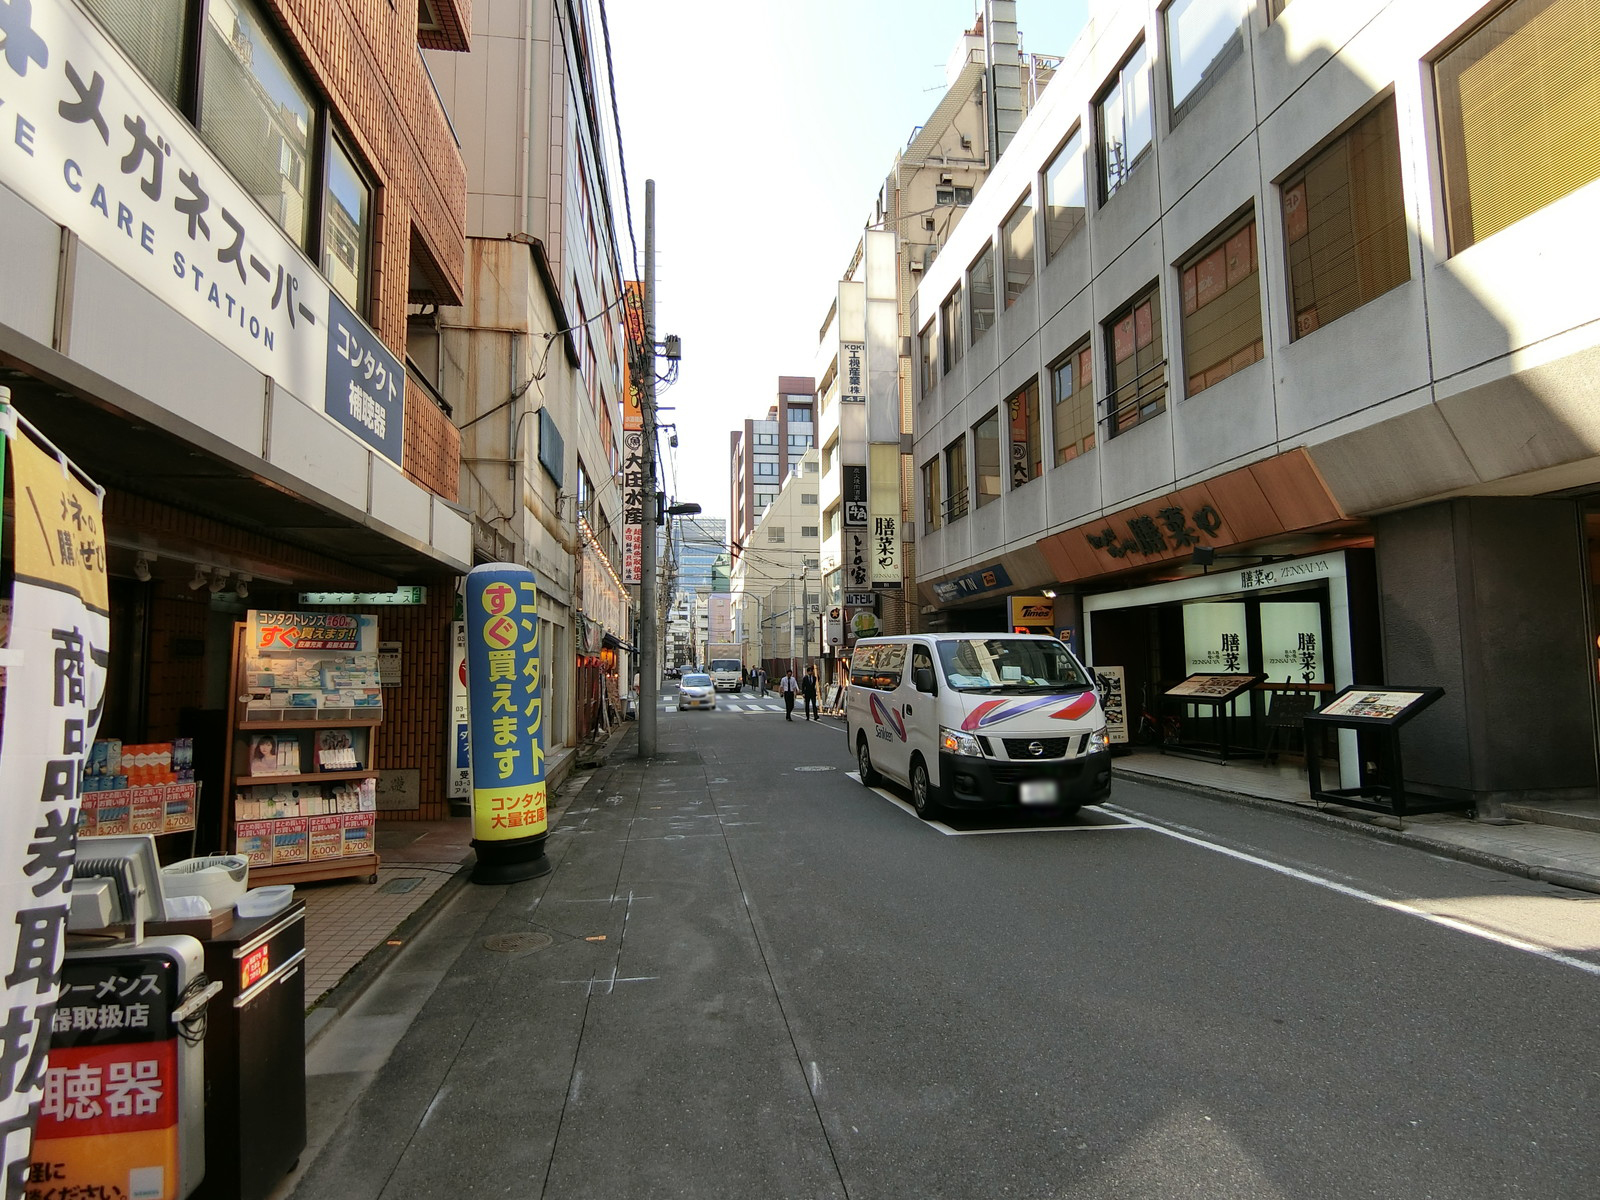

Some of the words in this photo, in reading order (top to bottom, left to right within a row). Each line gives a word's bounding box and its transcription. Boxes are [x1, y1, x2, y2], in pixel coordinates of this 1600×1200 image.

[58, 60, 316, 330] メガネスーパー
[63, 158, 155, 255] CARE
[173, 250, 275, 352] STATION
[336, 322, 398, 403] コンタクト
[348, 379, 387, 441] 補聴器
[625, 452, 642, 525] 大庄水産
[875, 517, 896, 570] 膳菜や
[845, 594, 873, 604] 山下ビル
[1240, 568, 1275, 589] 膳菜や
[259, 612, 326, 626] コンタクトレンズ
[1021, 605, 1052, 618] Times
[485, 585, 520, 780] すぐ買えます
[520, 581, 546, 777] コンタクト
[491, 790, 546, 812] コンタクト
[41, 1060, 164, 1122] 聴器
